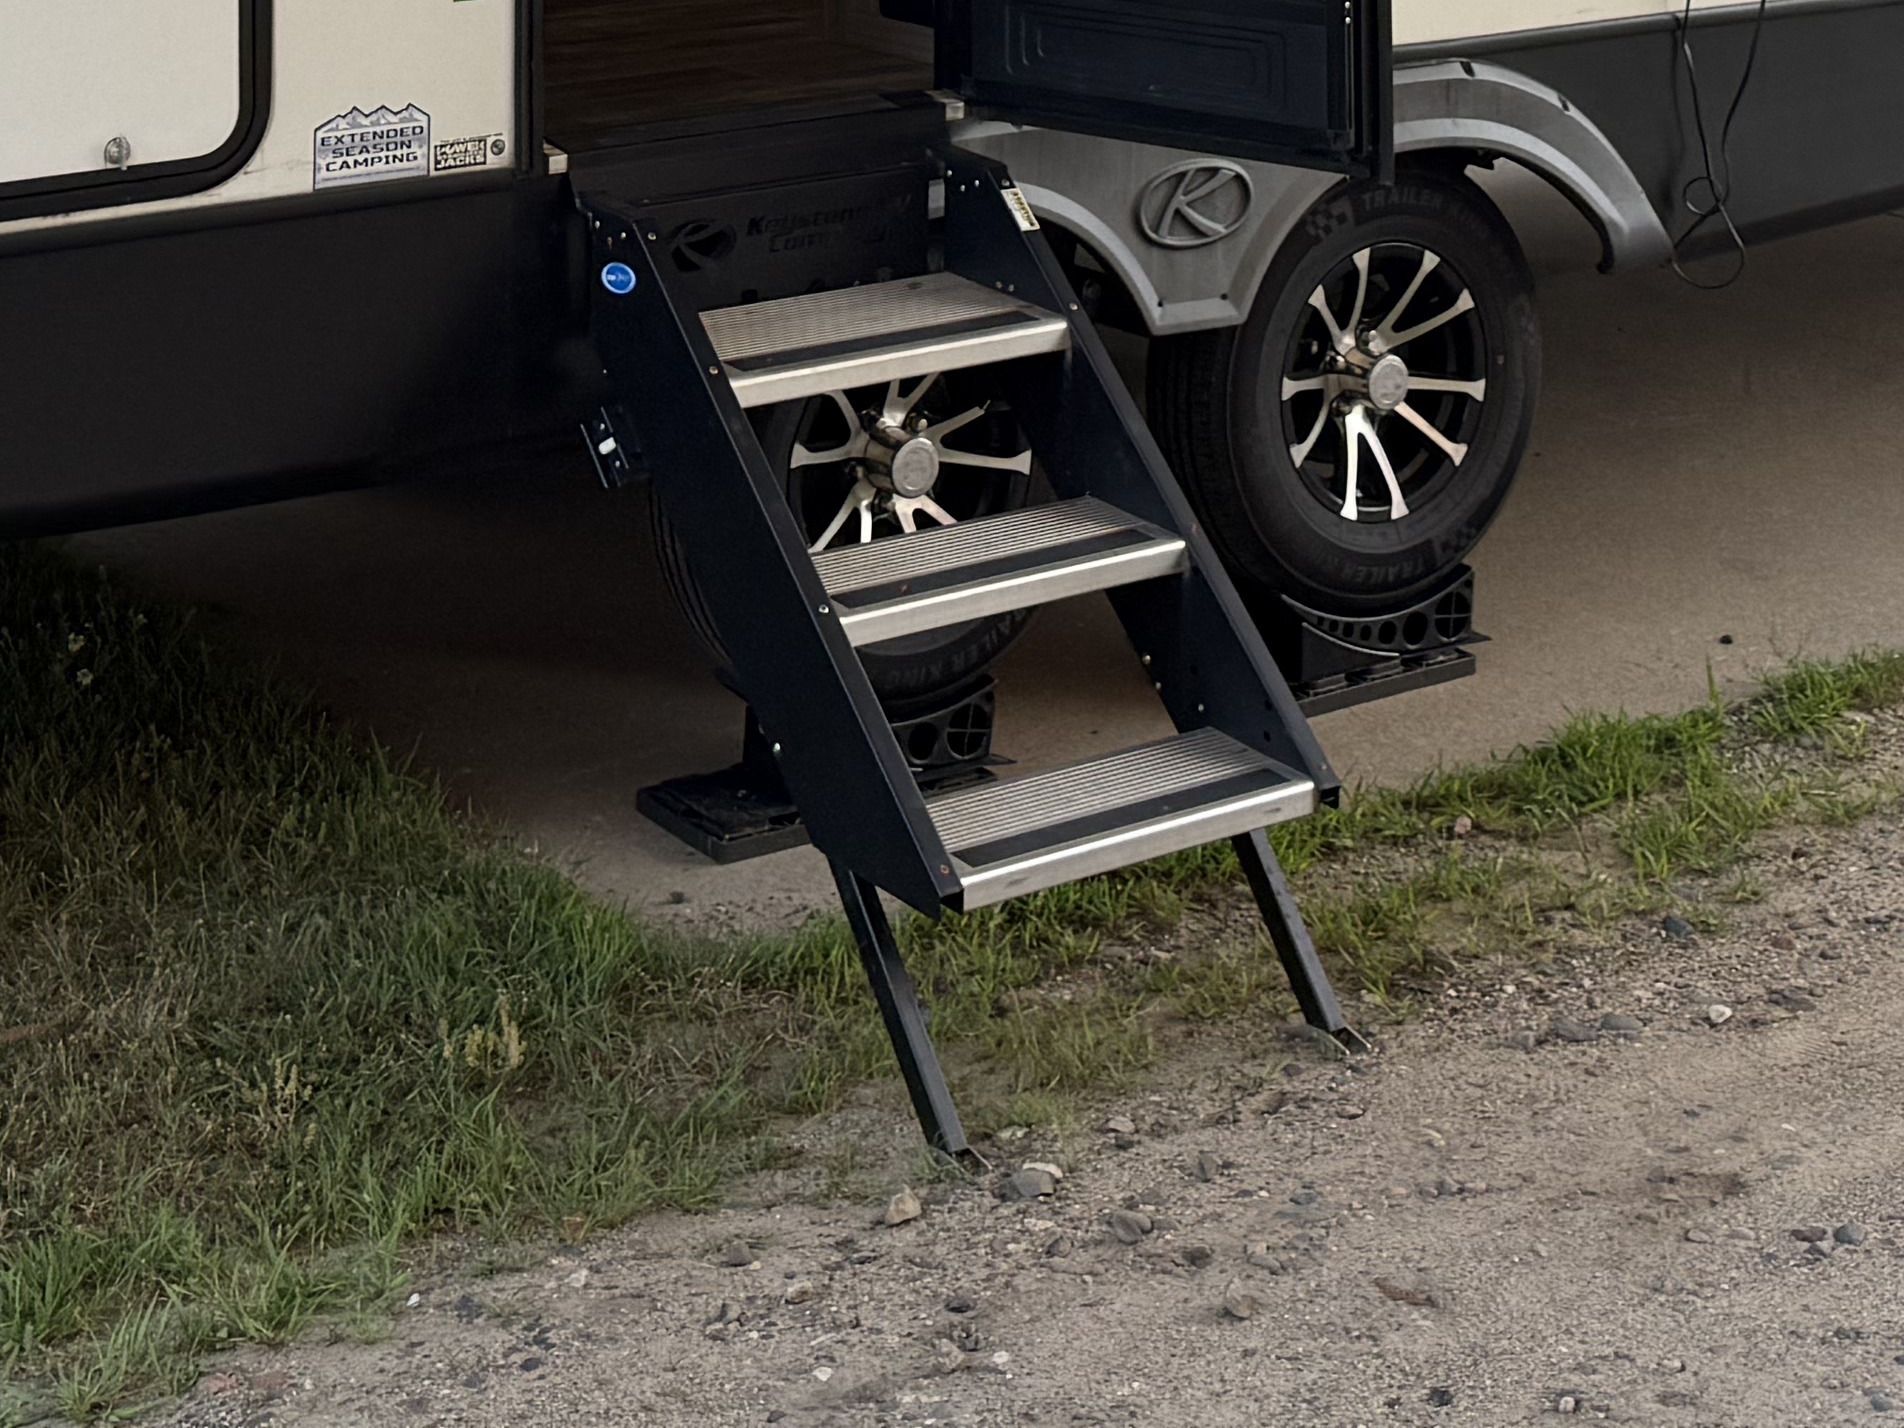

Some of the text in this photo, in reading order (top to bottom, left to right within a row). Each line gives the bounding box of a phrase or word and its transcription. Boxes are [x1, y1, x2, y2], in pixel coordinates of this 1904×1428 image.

[320, 125, 425, 147] EXTENDED
[331, 139, 413, 159] SEASON
[325, 151, 418, 172] CAMPING
